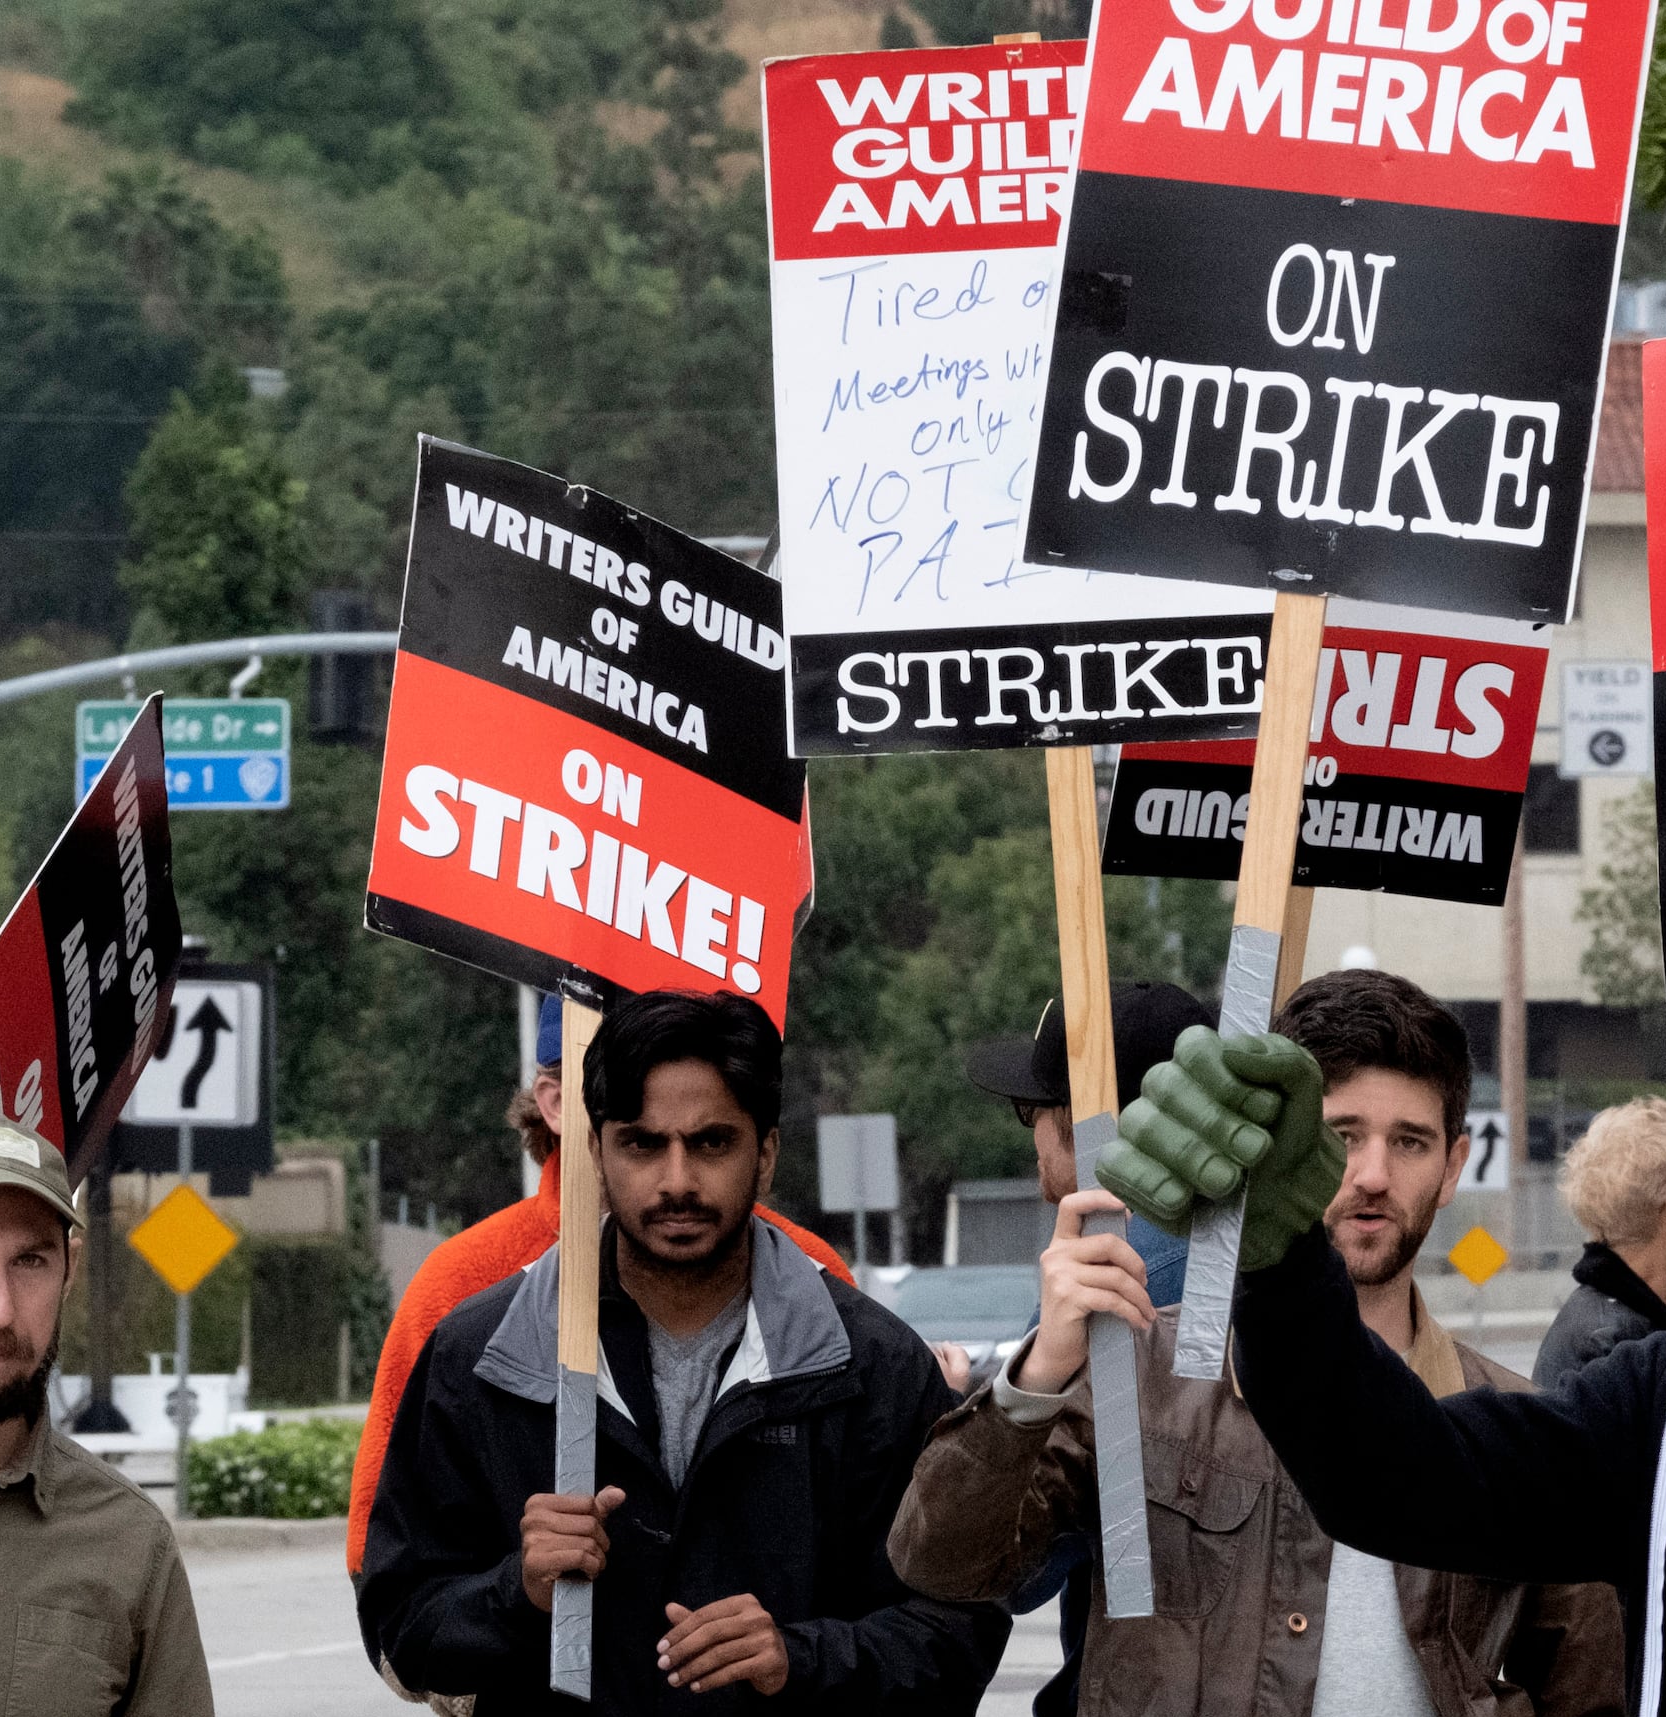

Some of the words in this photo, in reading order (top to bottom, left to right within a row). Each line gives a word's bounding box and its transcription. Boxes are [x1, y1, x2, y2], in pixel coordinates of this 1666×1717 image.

[1168, 0, 1477, 55] GUILD
[1485, 0, 1588, 66] OF
[817, 64, 1086, 125] WRIT
[1123, 38, 1596, 169] AMERICA
[832, 120, 1080, 180] GUIL
[813, 173, 1068, 233] AMER
[819, 260, 995, 345] Tired
[1266, 242, 1395, 355] ON
[822, 353, 989, 432] Meetings
[911, 399, 1011, 456] only
[1068, 351, 1560, 548] STRIKE
[810, 459, 980, 533] NOT
[445, 482, 651, 606] WRITERS
[659, 580, 785, 671] GUILD
[858, 520, 1051, 615] PAI
[591, 608, 639, 654] OF
[502, 625, 708, 754] AMERICA
[836, 636, 1264, 735] STRIKE
[213, 714, 245, 742] Dr
[561, 748, 643, 826] ON
[114, 756, 148, 958] WRITERS
[1300, 799, 1483, 864] WRITER
[399, 764, 765, 995] STRIKE!
[99, 941, 117, 995] OF
[61, 918, 99, 1121] AMERICA
[130, 948, 158, 1075] GUILD
